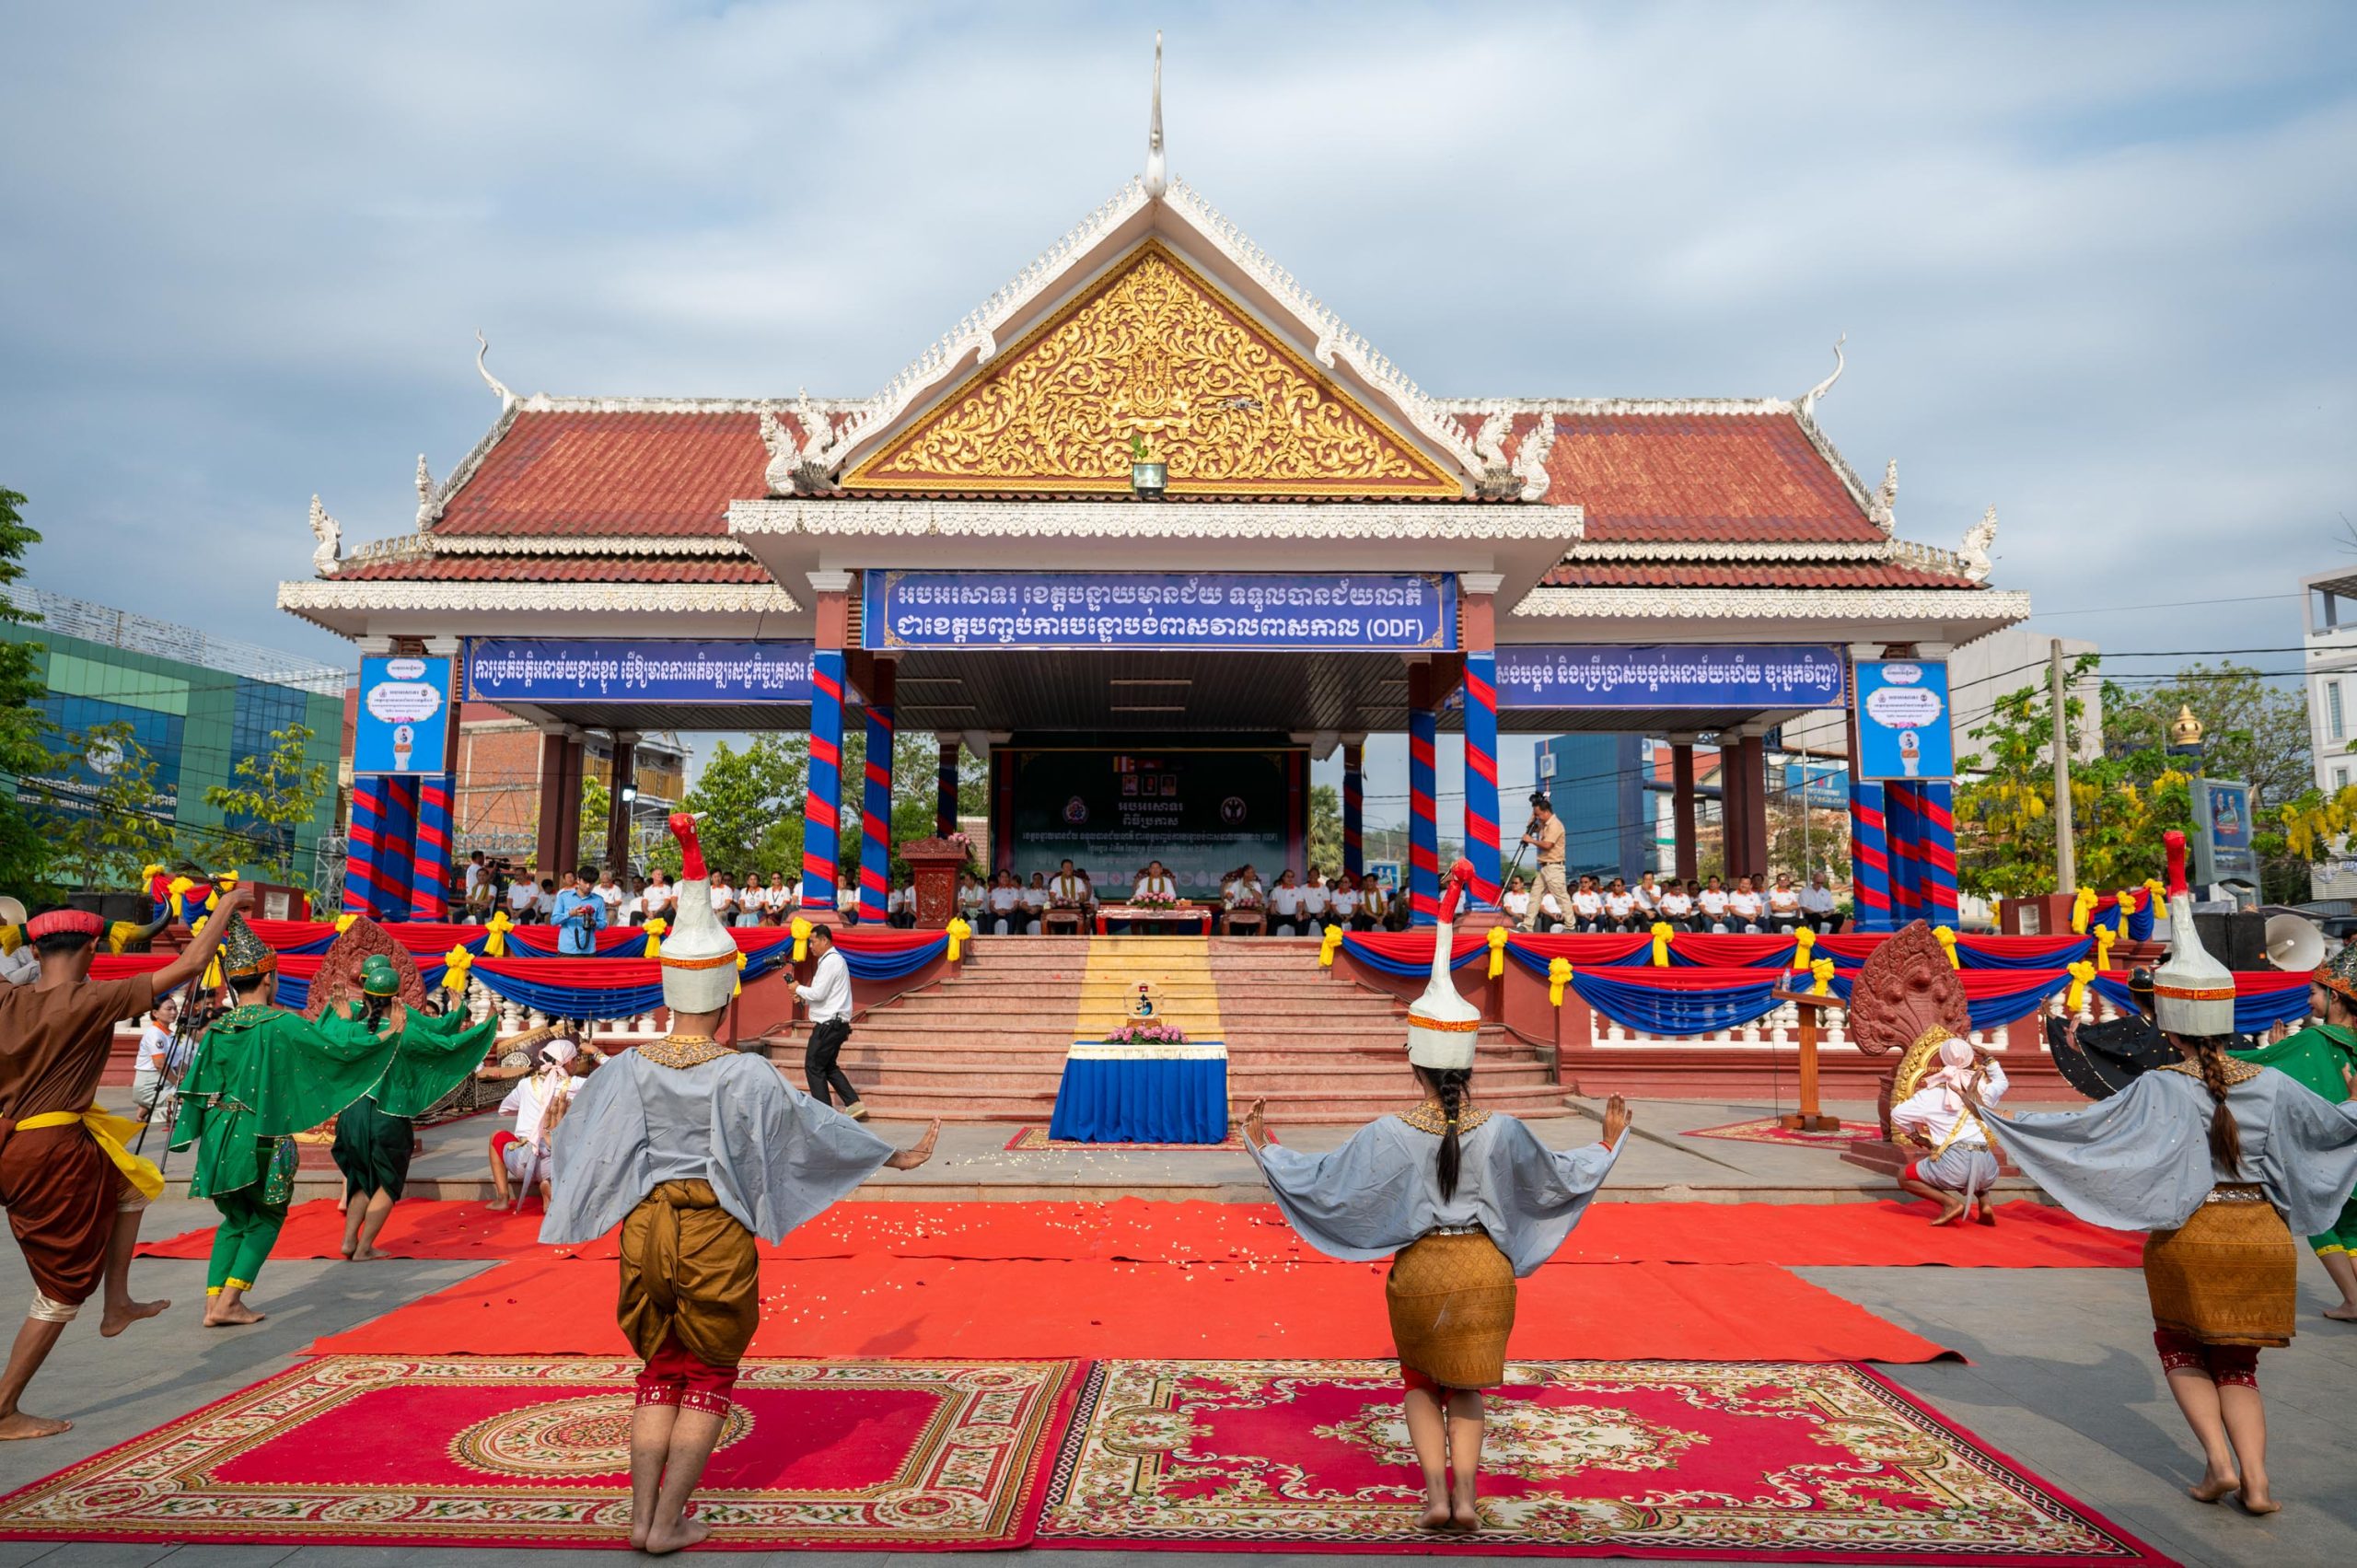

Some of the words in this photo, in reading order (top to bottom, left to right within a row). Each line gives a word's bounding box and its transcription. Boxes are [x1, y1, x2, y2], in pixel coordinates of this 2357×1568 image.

[898, 585, 1017, 605] អបអរសាទរ
[1024, 578, 1222, 611] ខេត្តបន្ទាយមានជ័យ
[1230, 579, 1422, 612] ទទួលបានជ័យលាភី
[1366, 618, 1424, 642] (ODF)
